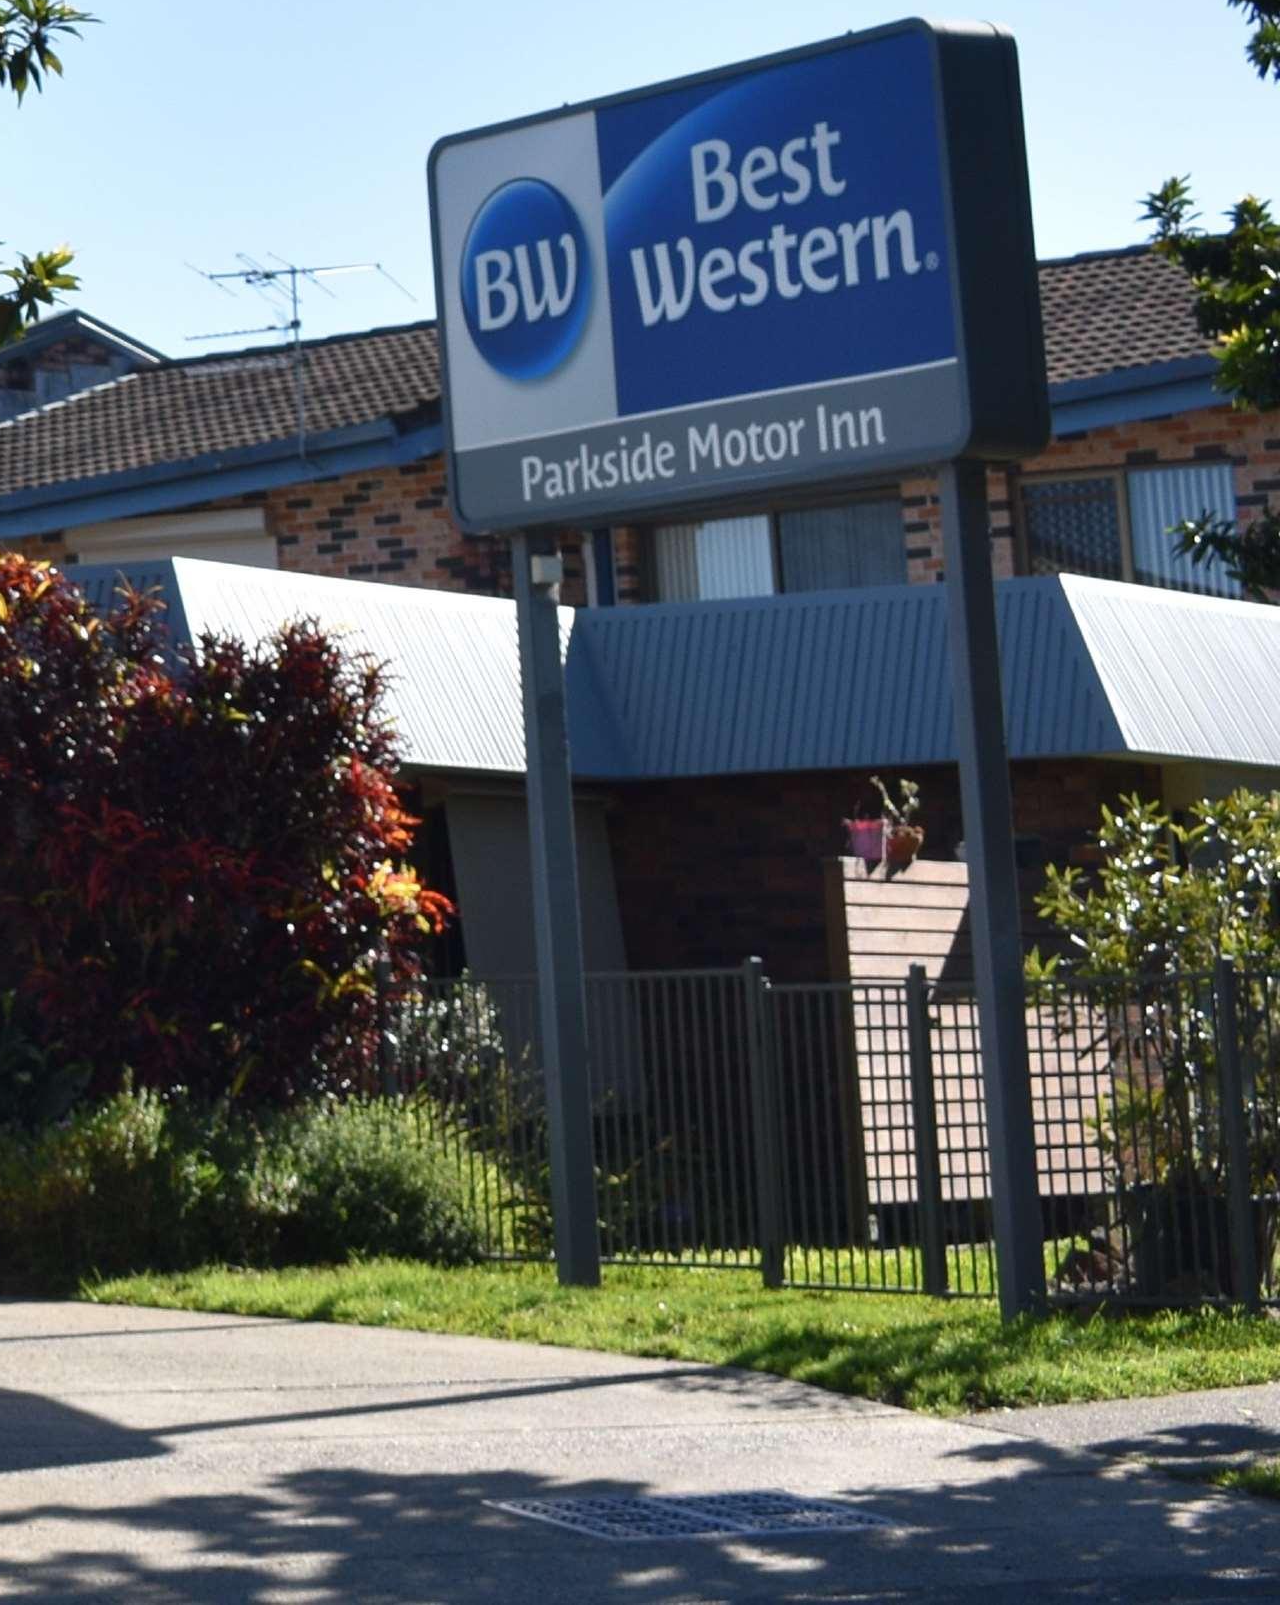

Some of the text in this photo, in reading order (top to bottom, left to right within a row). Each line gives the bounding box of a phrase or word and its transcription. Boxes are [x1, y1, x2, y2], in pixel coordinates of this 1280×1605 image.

[690, 122, 847, 224] Best
[474, 232, 578, 332] BW
[630, 207, 922, 327] Western
[520, 404, 886, 501] Parkside Motor Inn
